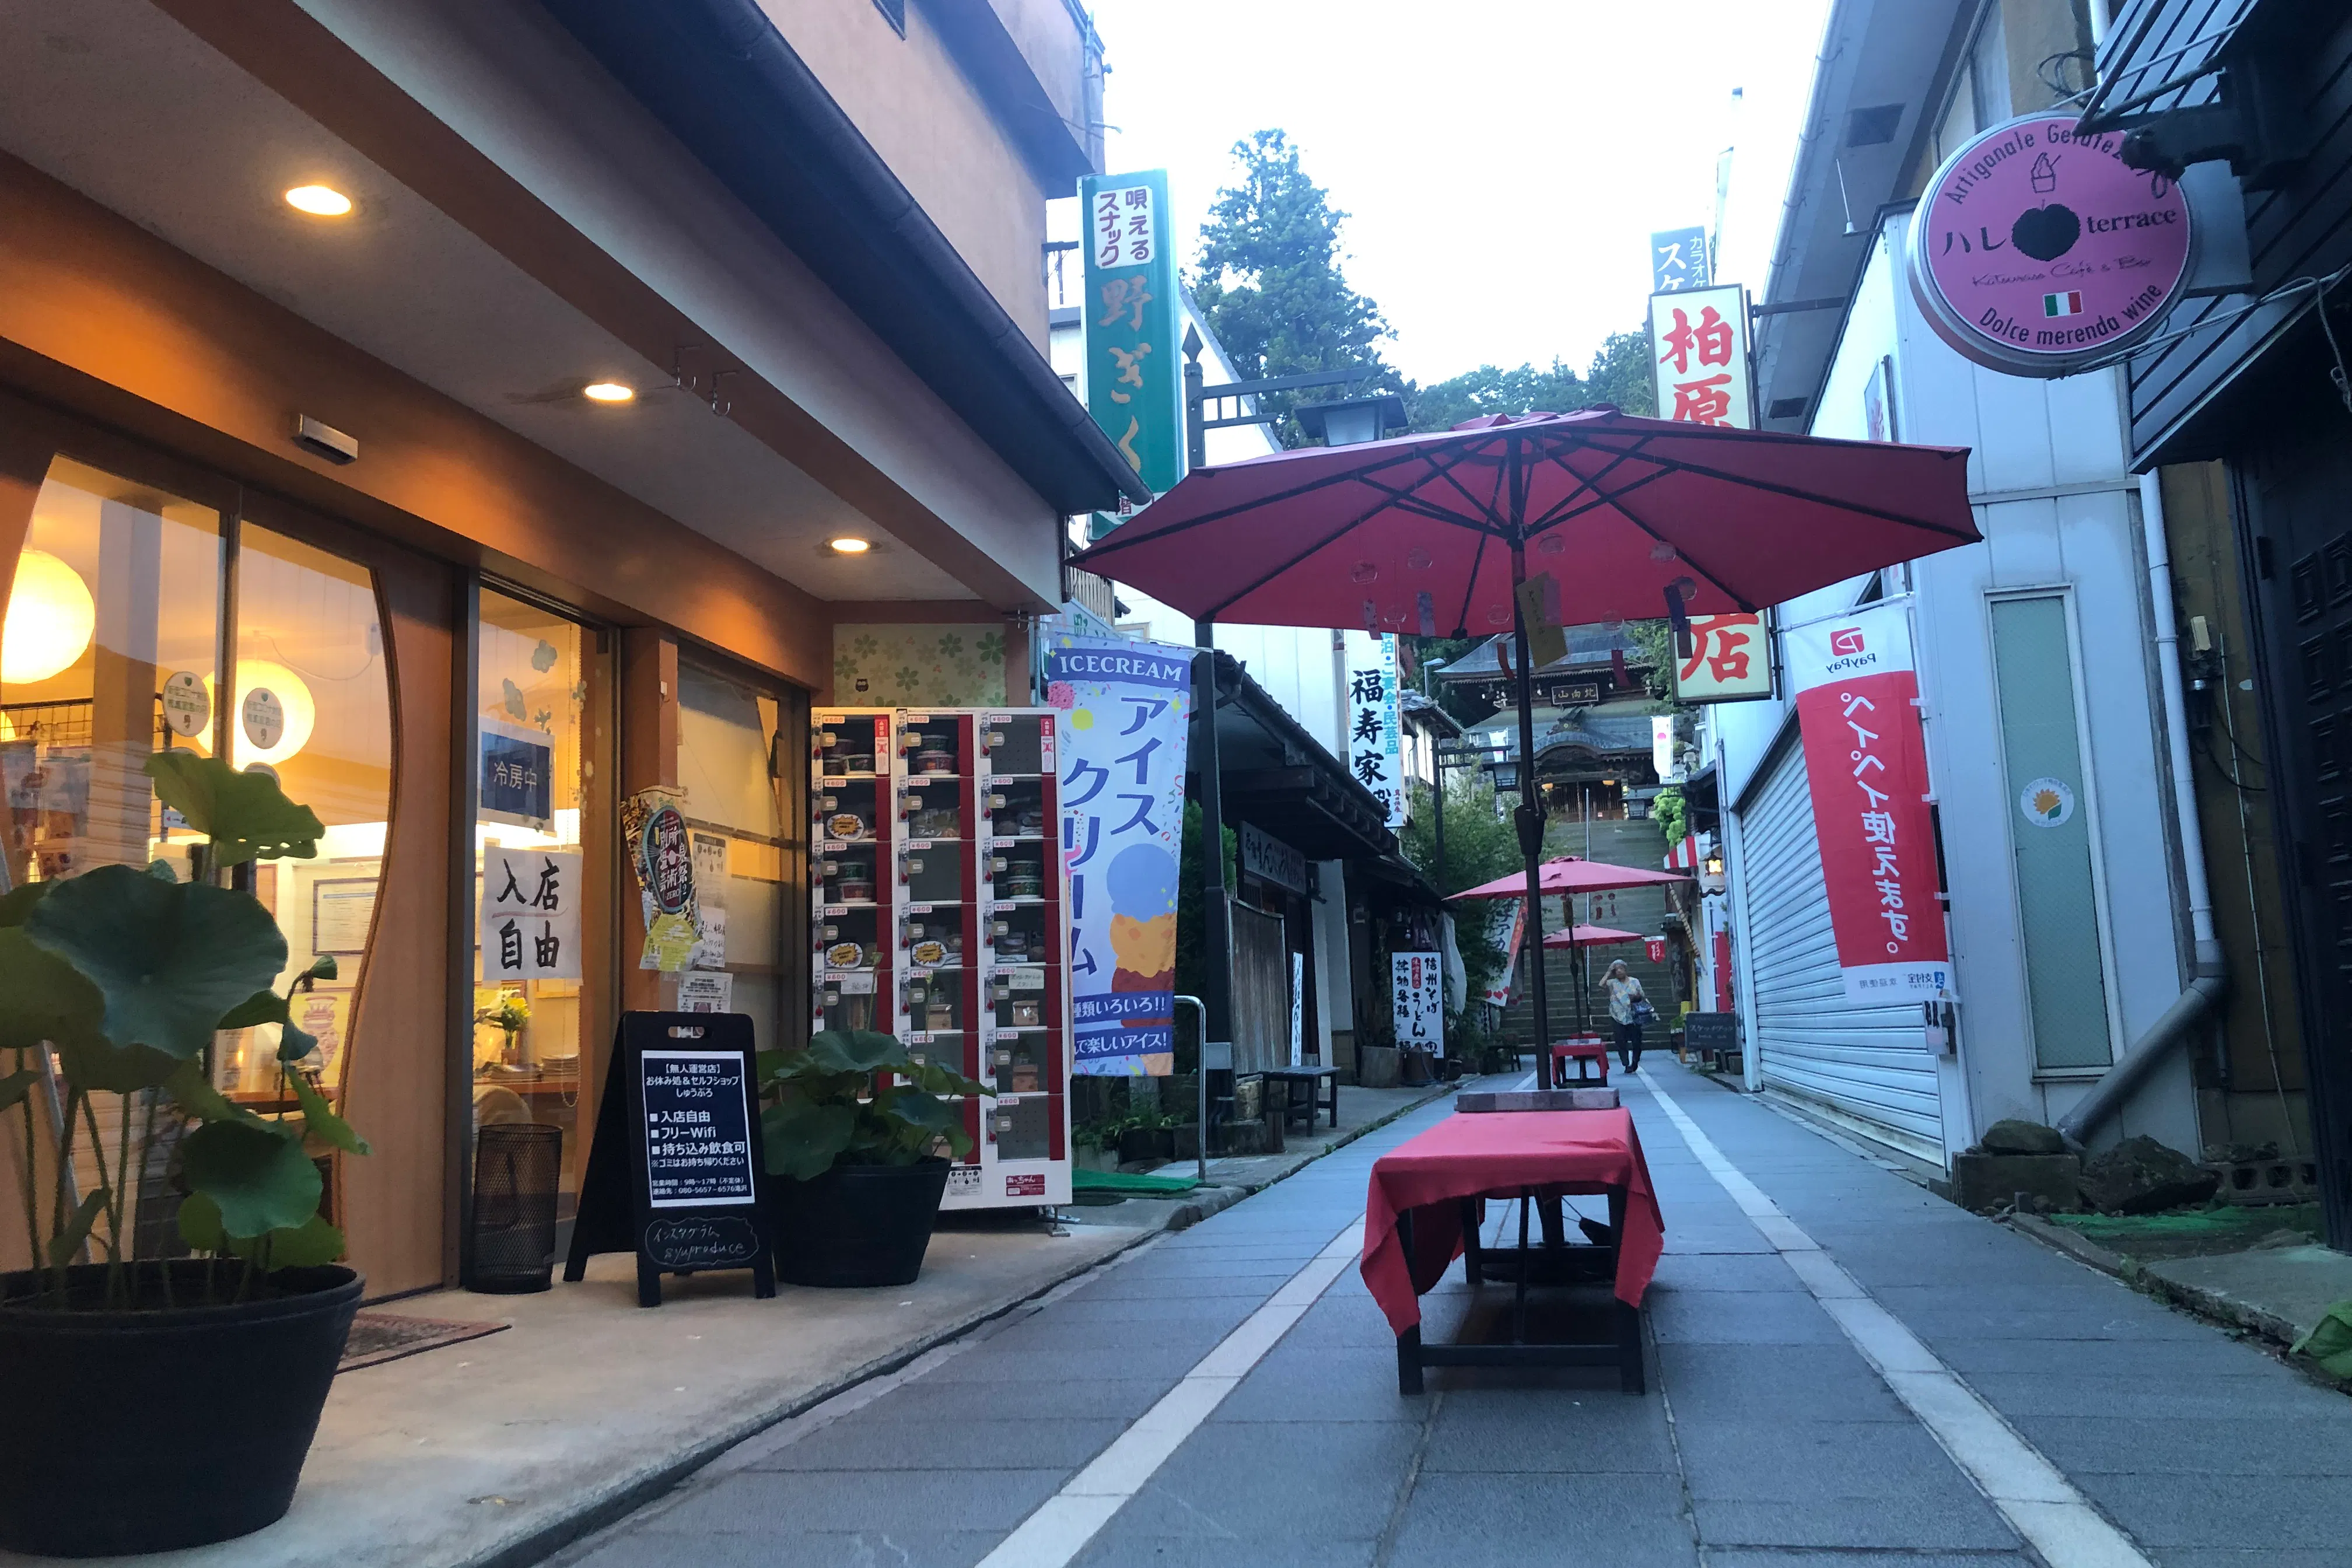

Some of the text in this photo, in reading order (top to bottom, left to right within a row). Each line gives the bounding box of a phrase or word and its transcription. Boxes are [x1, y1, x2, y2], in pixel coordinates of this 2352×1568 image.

[1098, 192, 1121, 267] スナック
[1125, 188, 1150, 261] 唄える
[1942, 226, 2007, 256] ハレ
[2085, 207, 2178, 235] terrace
[1657, 242, 1687, 291] スケ
[1689, 235, 1707, 288] カラオケ
[1979, 284, 2163, 346] Dolce merenda wine
[1097, 274, 1153, 474] 野ぎく
[1059, 653, 1184, 682] ICECREAM
[1349, 668, 1388, 786] 福寿家
[493, 760, 538, 793] 冷房中
[1110, 696, 1169, 836] アイス
[496, 856, 561, 911] 入店
[1062, 760, 1110, 977] クリーム
[498, 918, 561, 971] 自由
[1424, 957, 1440, 1014] 信州そば
[1412, 991, 1426, 1038] うどん
[660, 1110, 711, 1123] 入店自由
[660, 1126, 716, 1139] フリーWifi
[662, 1140, 746, 1156] 持ち込み飲食可
